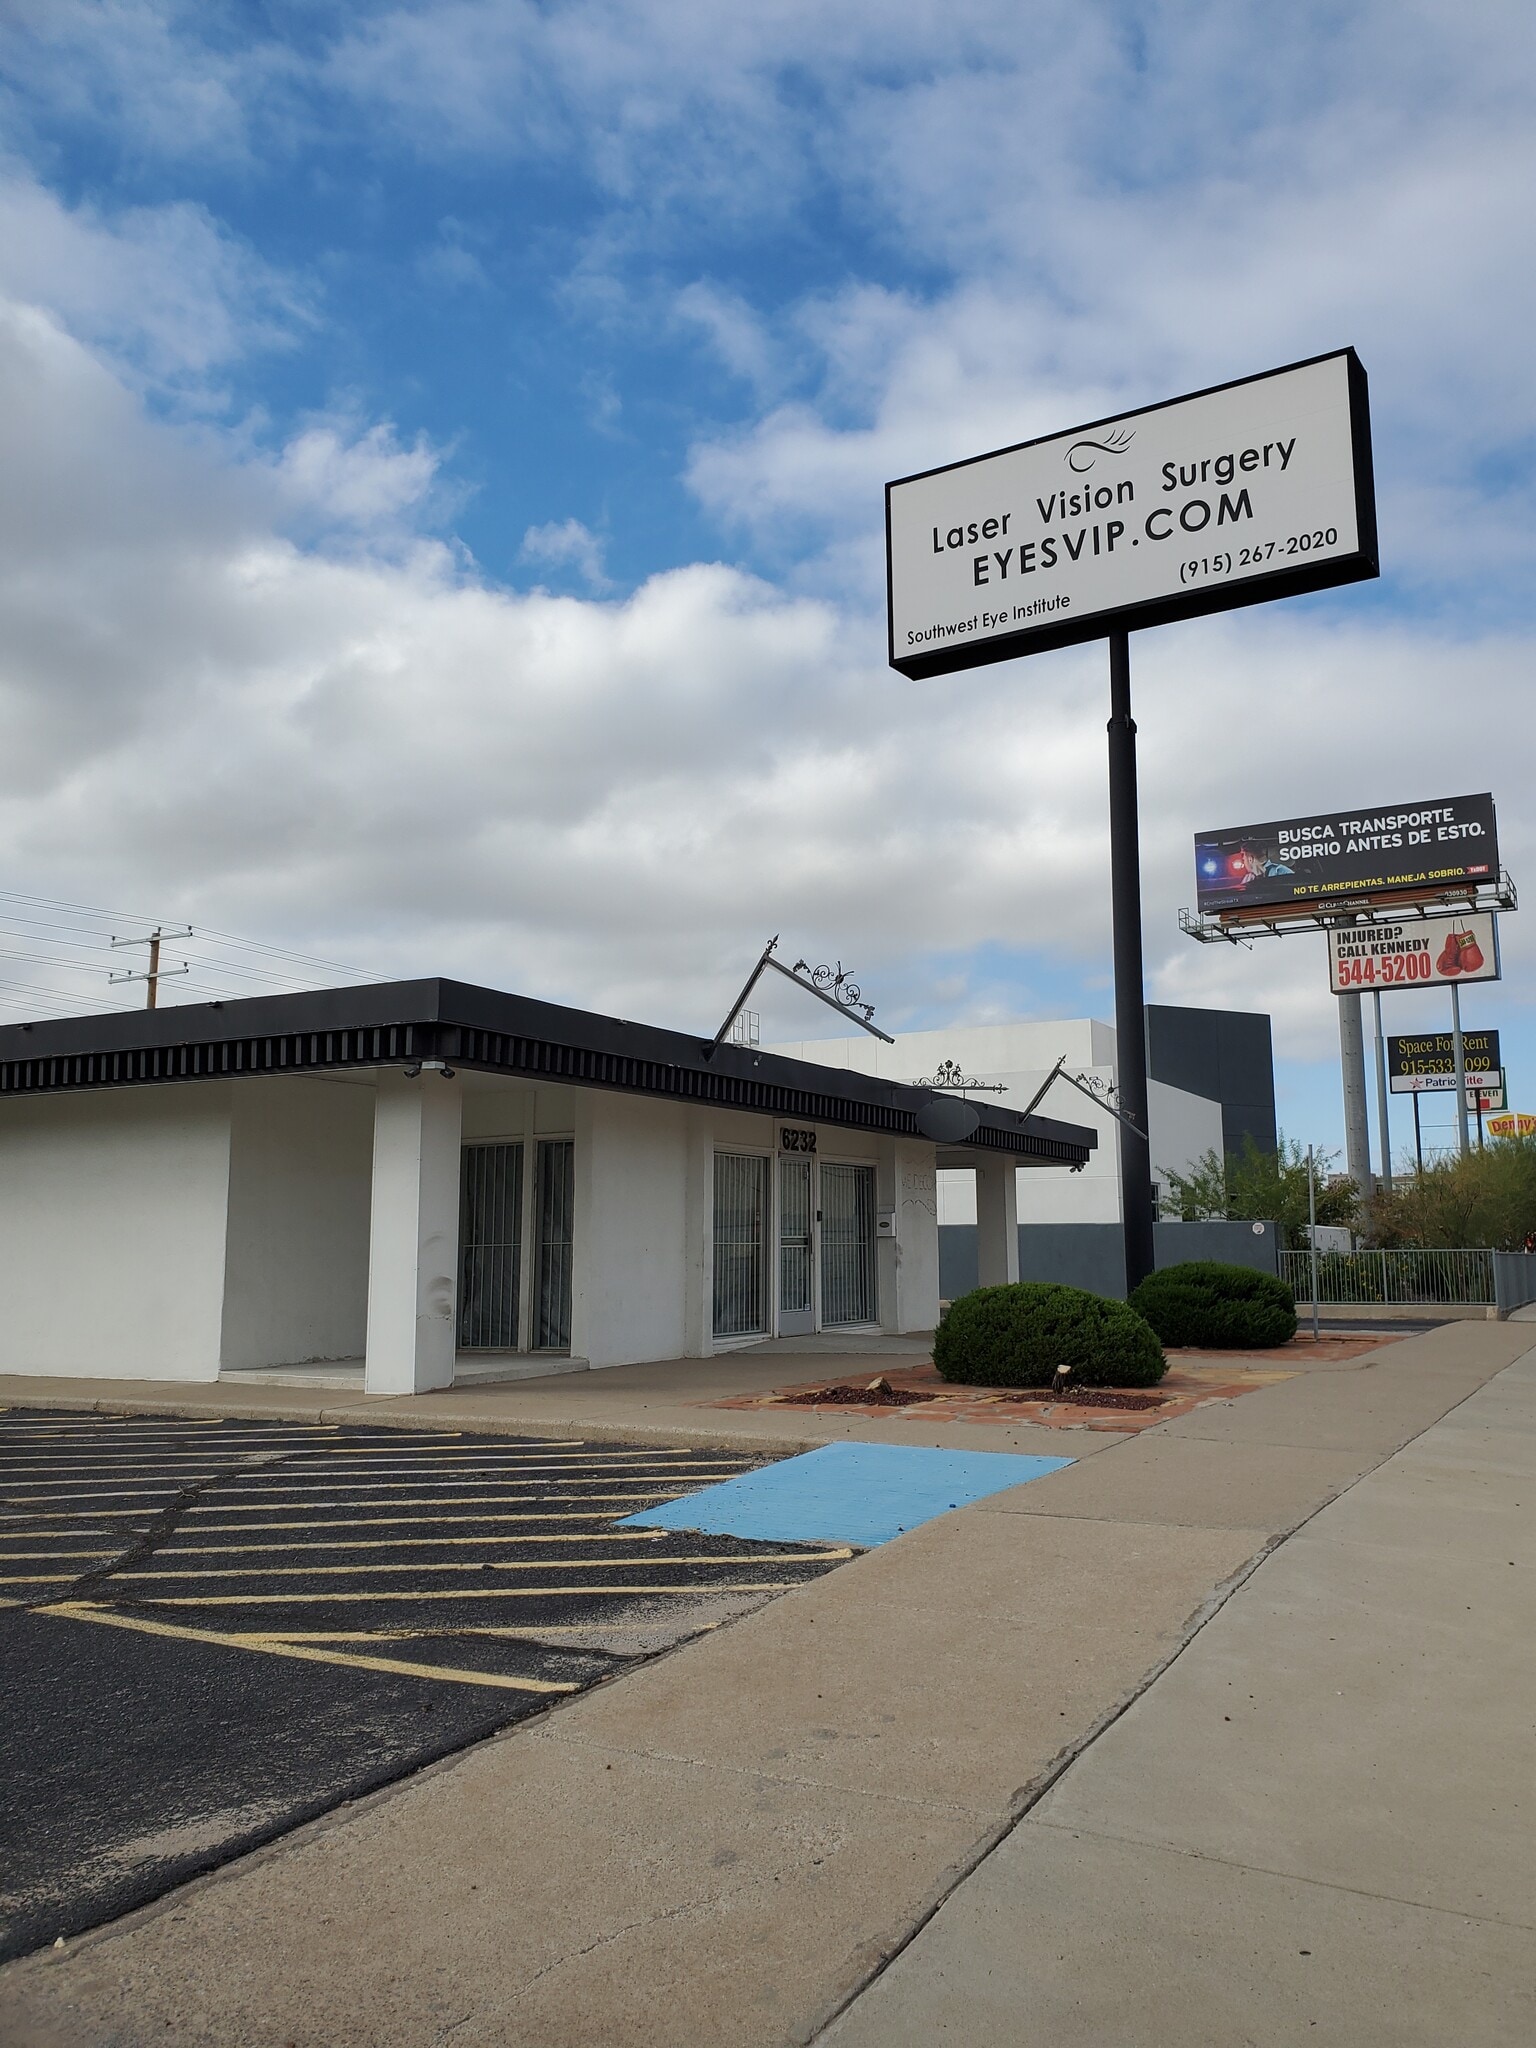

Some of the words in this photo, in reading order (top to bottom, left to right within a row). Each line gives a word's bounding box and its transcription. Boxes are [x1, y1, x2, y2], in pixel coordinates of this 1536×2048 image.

[932, 512, 1012, 554] Laser
[1036, 480, 1135, 524] Vision
[1161, 437, 1297, 492] Surgery
[973, 488, 1254, 586] EYESVIP.COM
[1179, 552, 1232, 584] (915)
[1239, 527, 1338, 566] 267-2020
[907, 615, 978, 645] Southwest
[982, 611, 1008, 629] Eye
[1013, 594, 1071, 620] Institute
[1278, 824, 1335, 844] BUSCA
[1338, 807, 1455, 836] TRANSPORTE
[1279, 841, 1341, 861] SOBRIO
[1346, 833, 1403, 854] ANTES
[1408, 829, 1432, 845] DE
[1437, 822, 1486, 841] ESTO.
[1293, 886, 1307, 895] NO
[1308, 885, 1319, 893] TE
[1321, 877, 1385, 892] ARREPIENTAS.
[1387, 872, 1426, 884] MANEJA
[1428, 867, 1466, 879] SOBRIO.
[1336, 926, 1403, 945] INJURED?
[1337, 944, 1368, 959] CALL
[1370, 938, 1430, 955] KENNEDY
[1338, 952, 1432, 986] 544-5200
[1398, 1038, 1433, 1058] Space
[1461, 1035, 1489, 1051] Rent
[1400, 1056, 1490, 1076] 915-533-099
[1425, 1076, 1457, 1087] Patrio
[1464, 1075, 1484, 1085] itle
[780, 1127, 817, 1153] 6232
